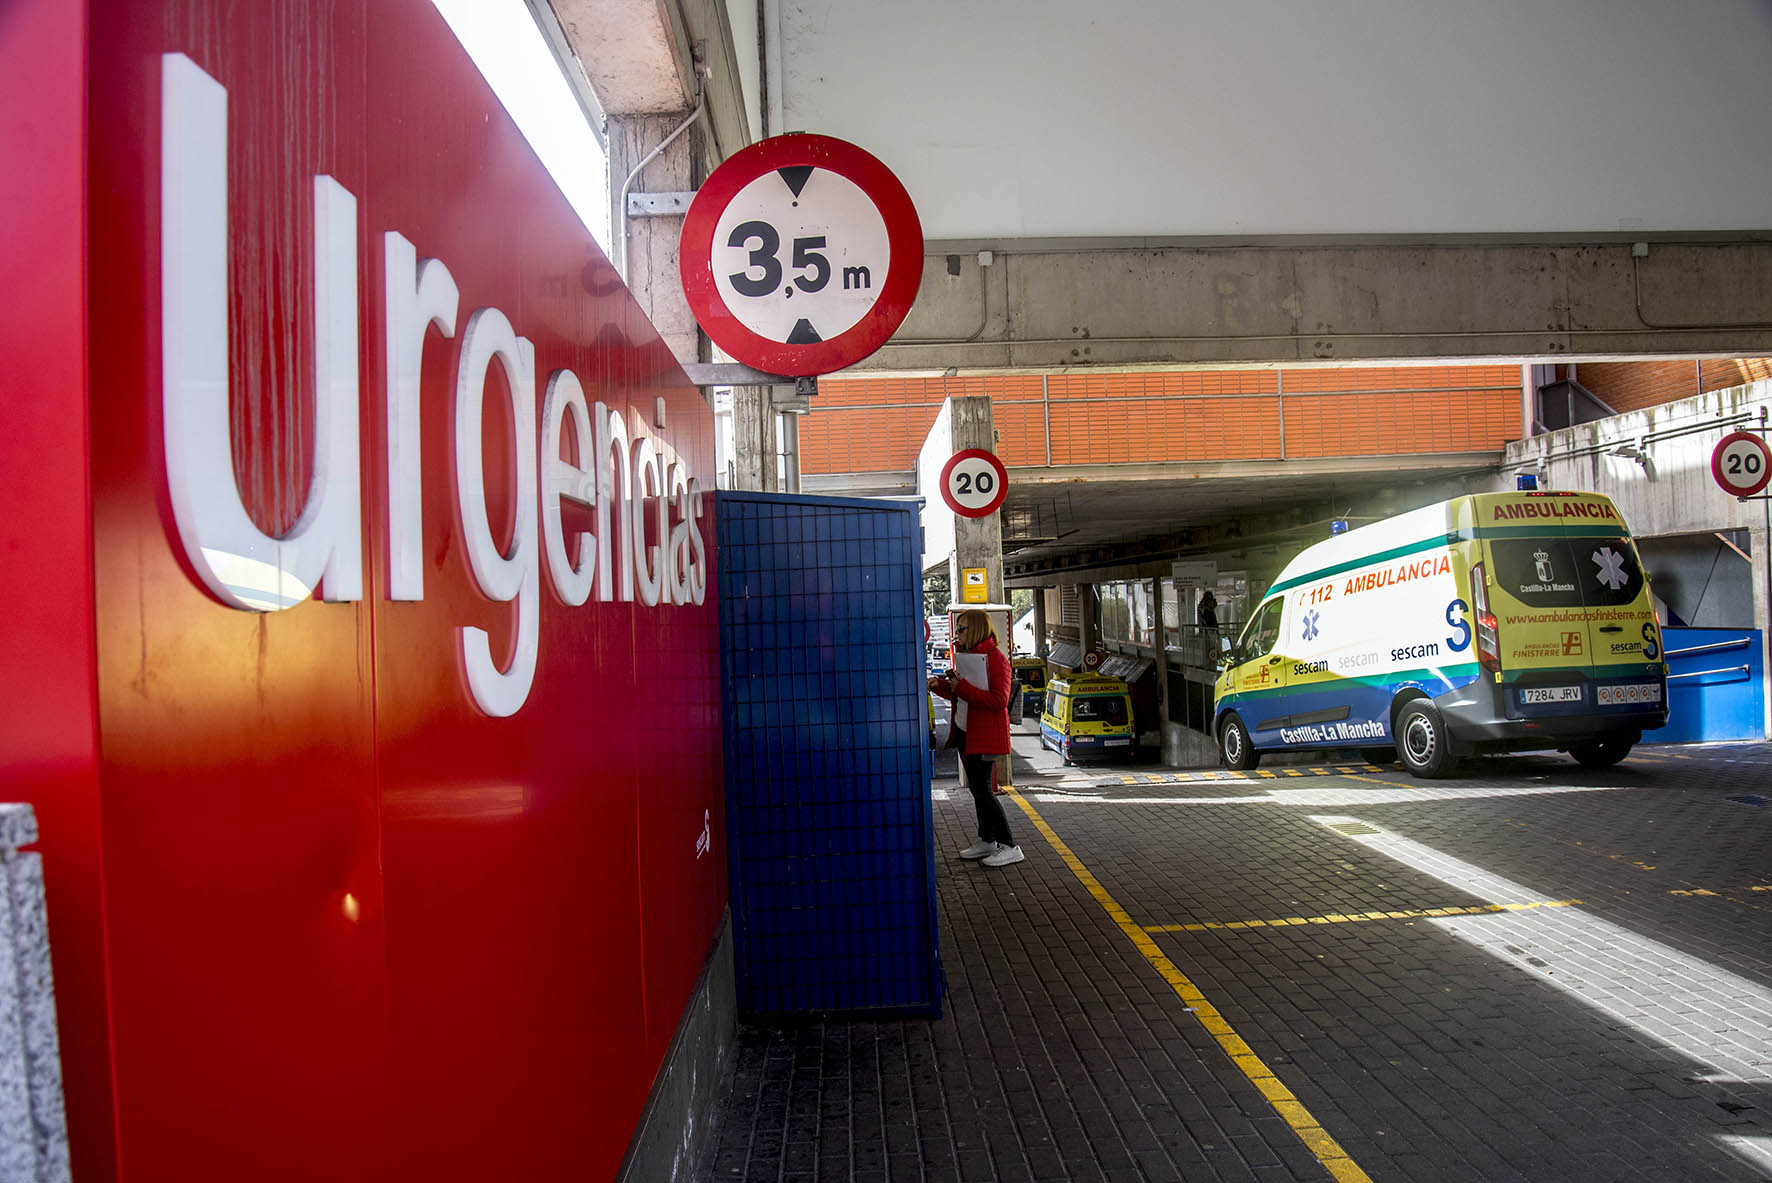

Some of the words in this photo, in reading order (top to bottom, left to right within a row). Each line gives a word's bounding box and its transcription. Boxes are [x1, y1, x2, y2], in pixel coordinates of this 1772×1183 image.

[727, 220, 831, 298] 3,5
[843, 265, 871, 289] m
[160, 52, 706, 717] urgencias
[1727, 453, 1761, 474] 20
[956, 472, 993, 494] 20
[1493, 503, 1616, 520] AMBULANCIA
[1310, 584, 1333, 605] 112
[1344, 555, 1450, 596] AMBULANCIA
[1294, 658, 1329, 675] sescam
[1338, 650, 1379, 669] sescam
[1391, 641, 1439, 661] sescam
[1512, 649, 1560, 658] FINISTERRE
[1611, 642, 1642, 652] sescam
[1527, 690, 1554, 701] 7284
[1560, 688, 1580, 700] JRV
[1280, 724, 1336, 744] Castilla-La
[1339, 719, 1386, 741] Mancha
